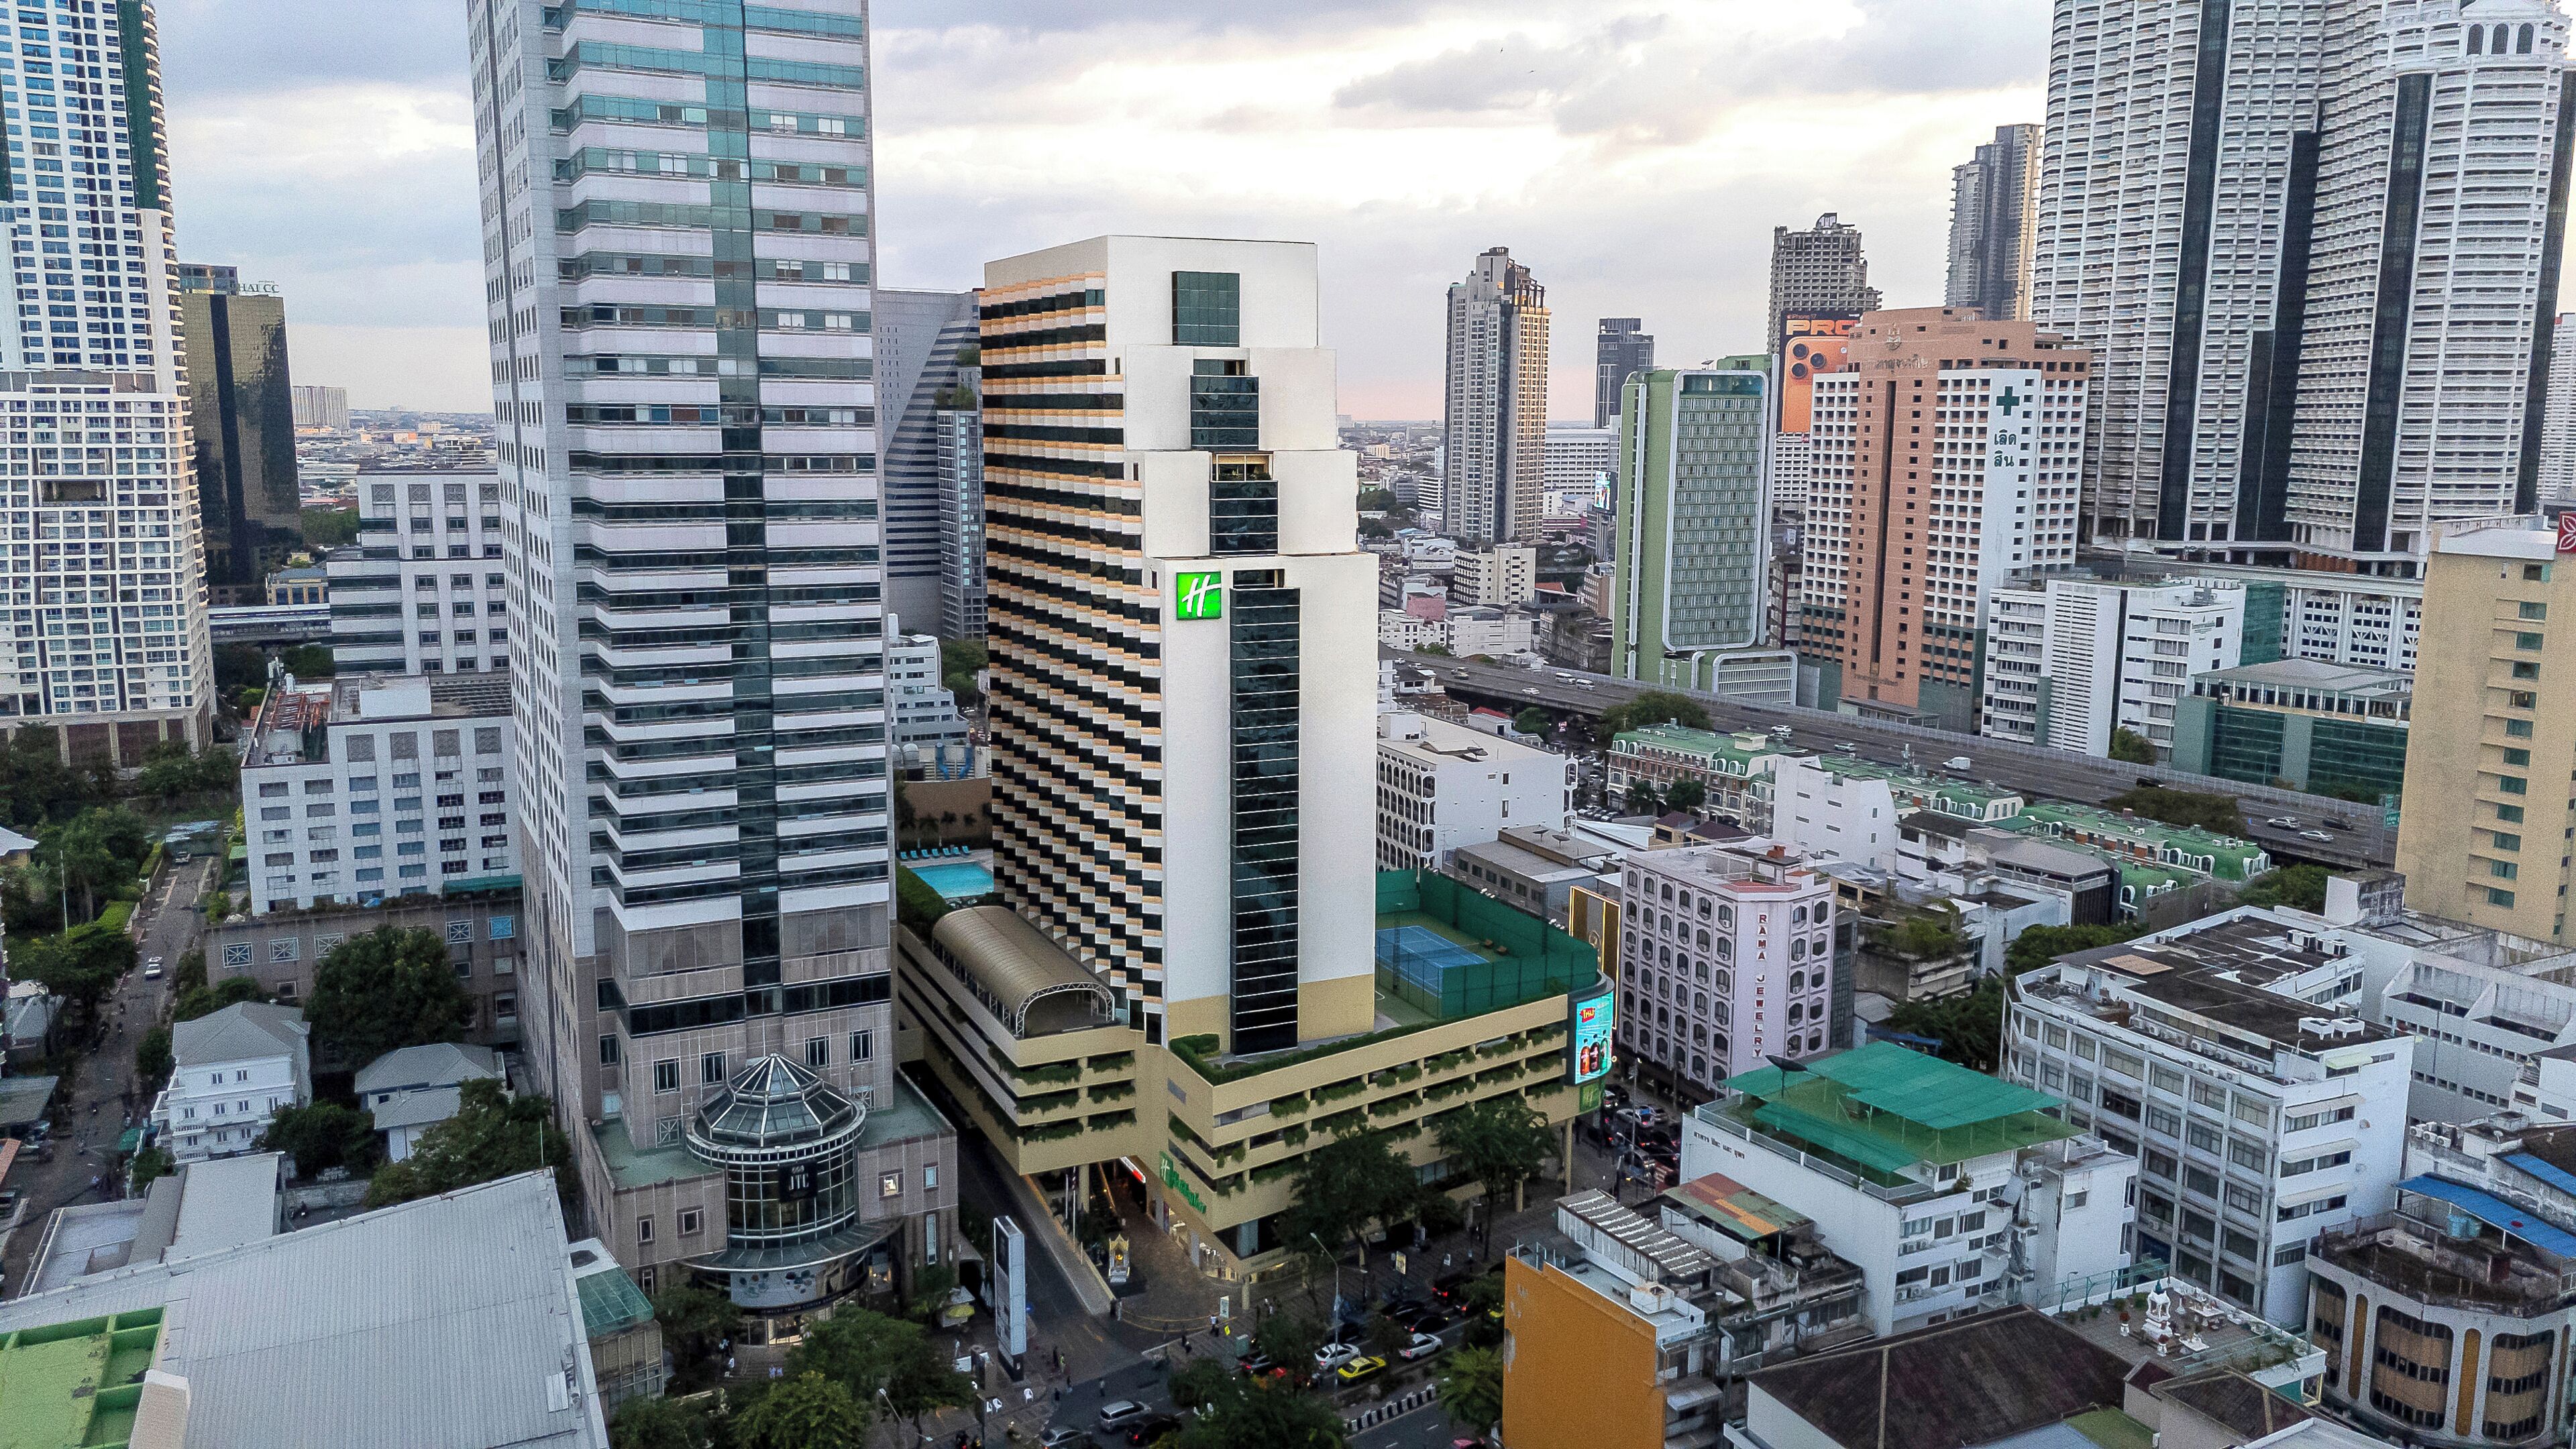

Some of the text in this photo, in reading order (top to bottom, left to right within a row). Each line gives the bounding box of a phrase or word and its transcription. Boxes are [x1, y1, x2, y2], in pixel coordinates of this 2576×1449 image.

[1994, 429, 2017, 445] เลิด
[1994, 450, 2015, 467] สิน
[1758, 914, 1767, 960] RAMA
[1754, 975, 1765, 1057] JEWELRY
[788, 1173, 809, 1191] JTC
